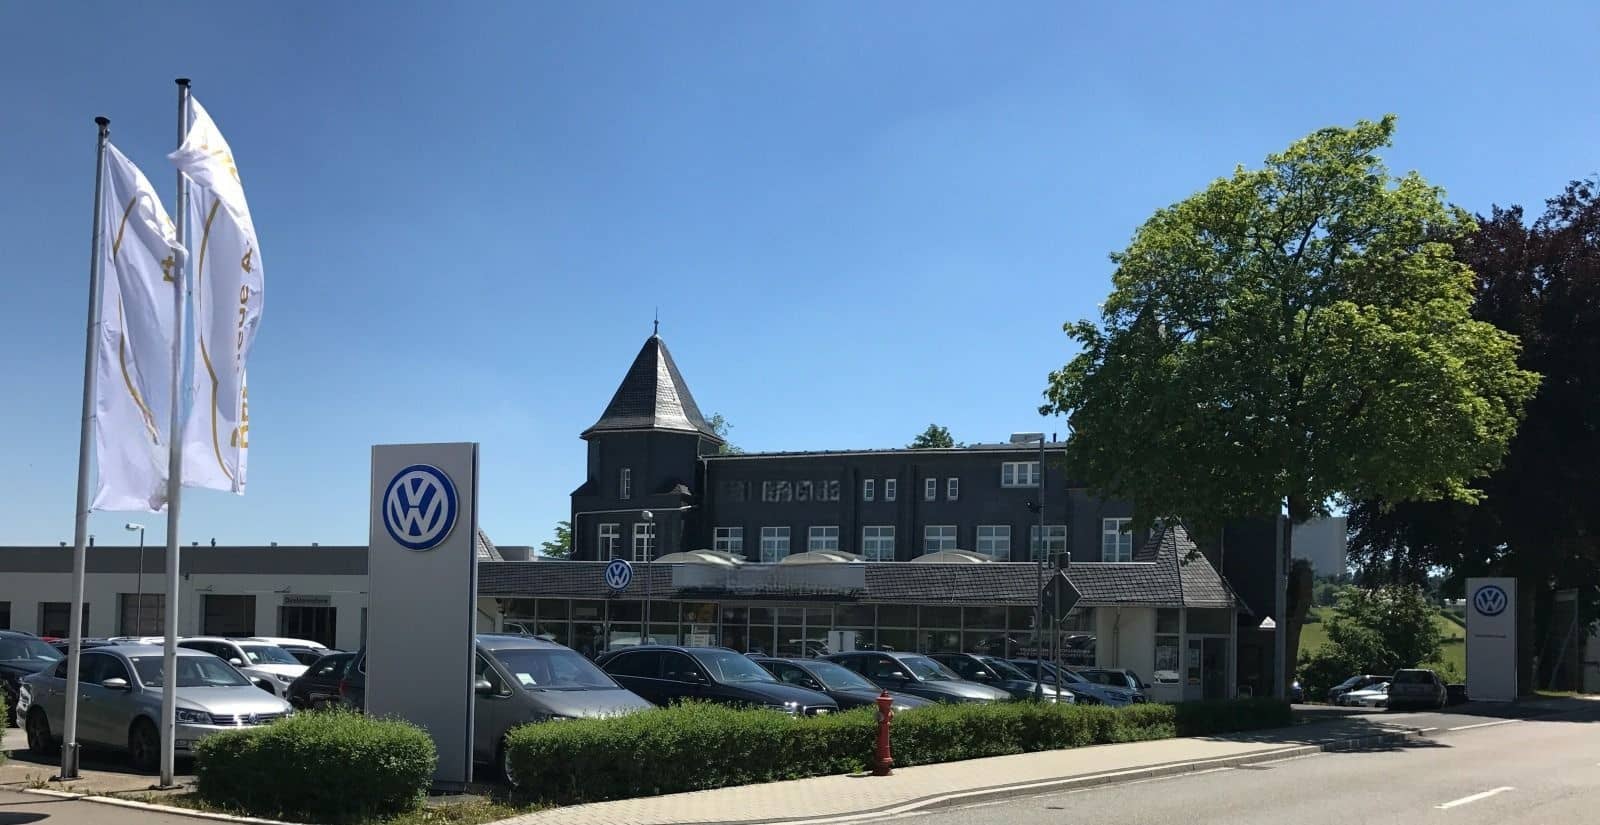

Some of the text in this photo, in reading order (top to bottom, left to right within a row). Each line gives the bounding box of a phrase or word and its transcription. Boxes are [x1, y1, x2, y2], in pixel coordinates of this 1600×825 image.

[386, 468, 452, 547] VW
[606, 561, 630, 589] VW
[1475, 587, 1506, 615] VW
